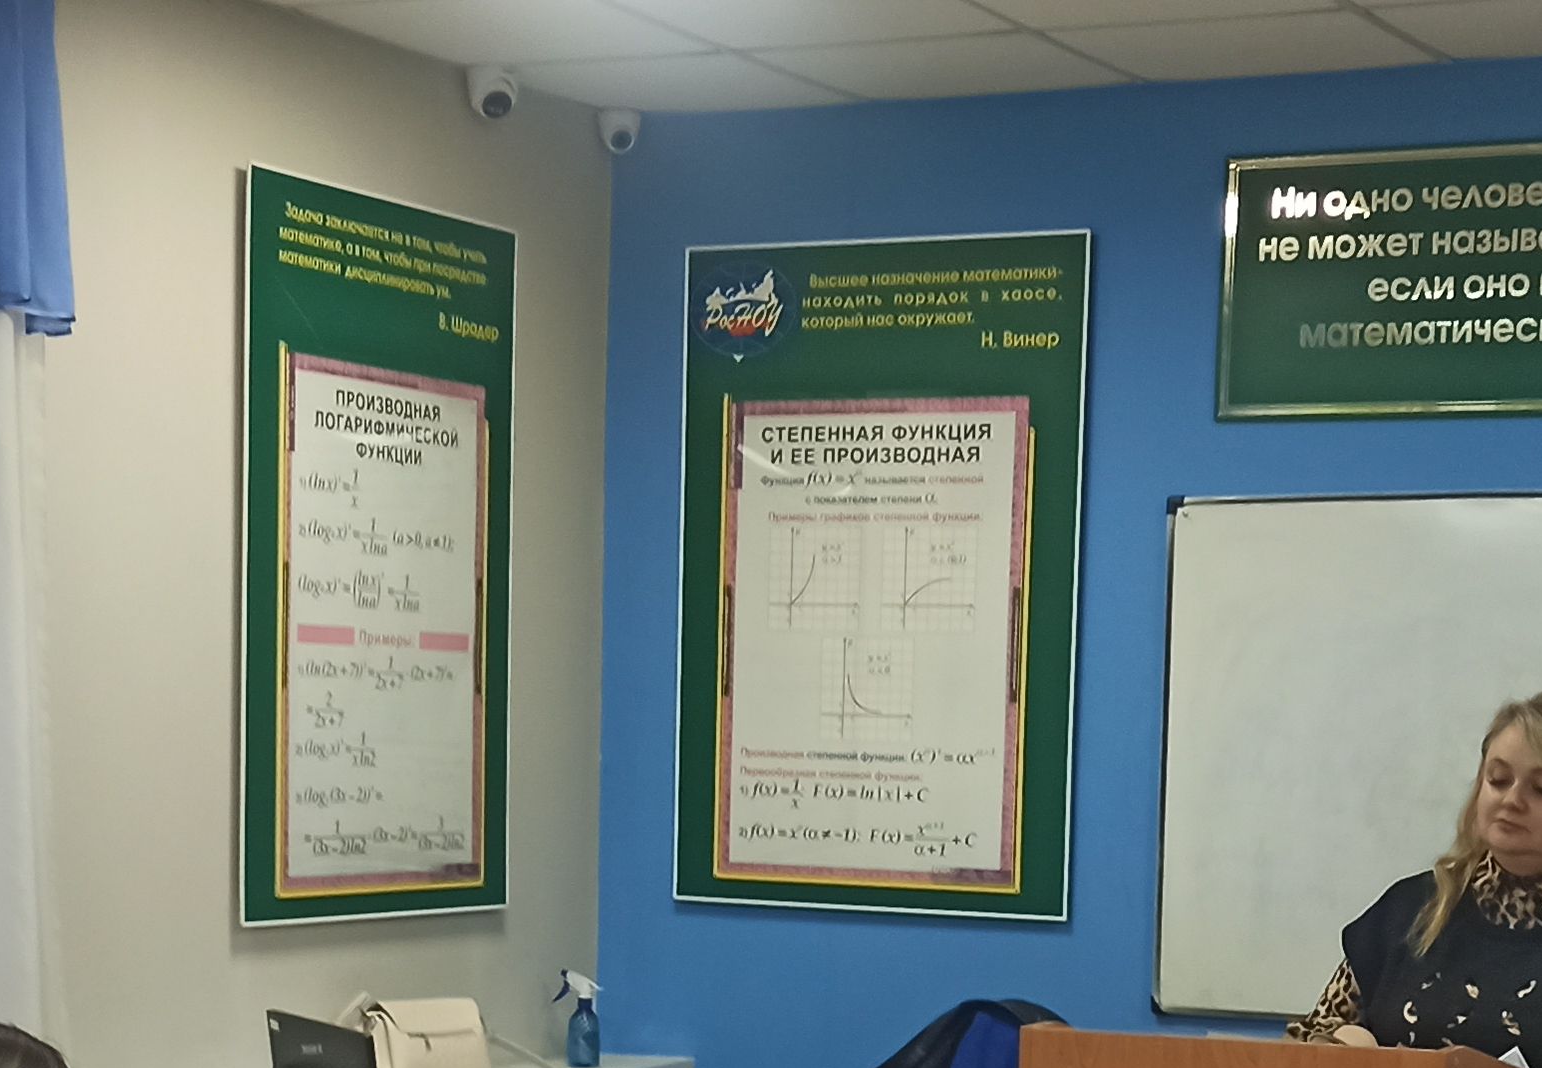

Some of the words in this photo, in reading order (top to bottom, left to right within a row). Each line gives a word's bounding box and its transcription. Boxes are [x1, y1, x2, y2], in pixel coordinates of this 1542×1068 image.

[1271, 186, 1318, 220] Ни
[1323, 185, 1414, 221] одно
[285, 201, 323, 226] Задача
[325, 214, 389, 242] заключается
[391, 231, 404, 246] не
[279, 226, 344, 255] математике,
[346, 244, 354, 256] а
[361, 245, 383, 264] том,
[384, 252, 412, 270] чтобы
[413, 257, 431, 275] при
[1258, 236, 1300, 263] не
[1307, 228, 1424, 261] может
[279, 249, 341, 275] математики
[344, 265, 434, 296] дисциплинировать
[436, 284, 452, 299] ум.
[809, 273, 869, 289] Высшее
[871, 270, 961, 288] назначение
[1367, 271, 1456, 302] если
[1462, 269, 1530, 300] оно
[705, 292, 783, 337] РосНОУ
[802, 292, 883, 310] находить
[894, 290, 969, 307] порядок
[980, 289, 989, 302] в
[438, 311, 450, 332] В.
[452, 315, 500, 343] Шрадер
[801, 313, 864, 332] который
[866, 313, 896, 327] нас
[898, 310, 975, 330] окружает.
[981, 331, 999, 349] Н.
[1003, 330, 1060, 350] Винер
[335, 388, 441, 422] ПРОИЗВОДНАЯ
[314, 410, 459, 447] ЛОГАРИФМИЧЕСКОЙ
[761, 424, 885, 444] СТЕПЕННАЯ
[892, 422, 993, 444] ФУНКЦИЯ
[356, 442, 423, 467] ФУНКЦИИ
[770, 448, 784, 466] И
[790, 447, 815, 465] ЕЕ
[823, 446, 981, 468] ПРОИЗВОДНАЯ
